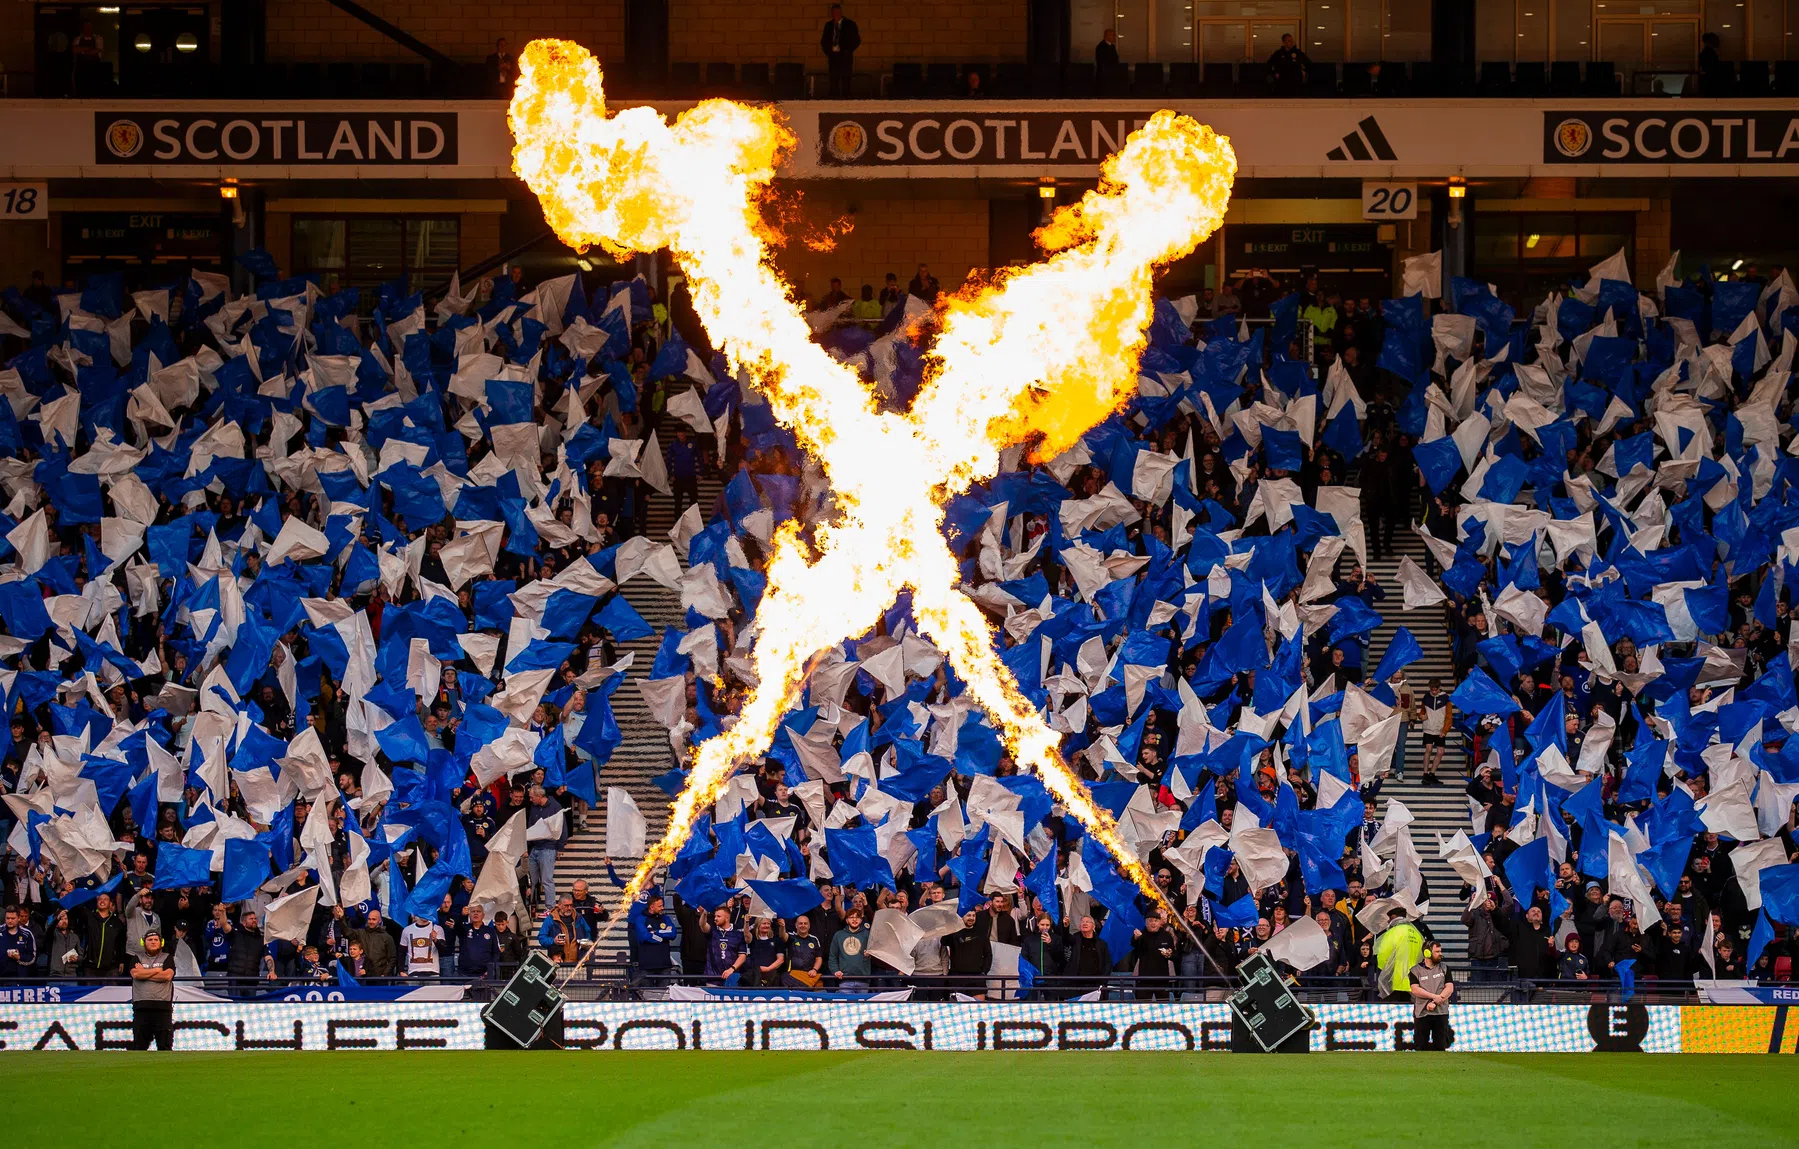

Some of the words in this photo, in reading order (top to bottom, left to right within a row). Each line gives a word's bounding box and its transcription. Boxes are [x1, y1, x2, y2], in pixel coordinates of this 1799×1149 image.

[153, 119, 445, 160] SCOTLAND
[876, 119, 1147, 161] SCOTLAN
[1601, 118, 1799, 159] SCOTLA
[4, 188, 38, 214] 18
[1367, 187, 1412, 214] 20
[105, 229, 125, 238] EXIT
[129, 216, 163, 228] EXIT
[1268, 243, 1288, 252] EXIT
[1292, 230, 1325, 243] EXIT
